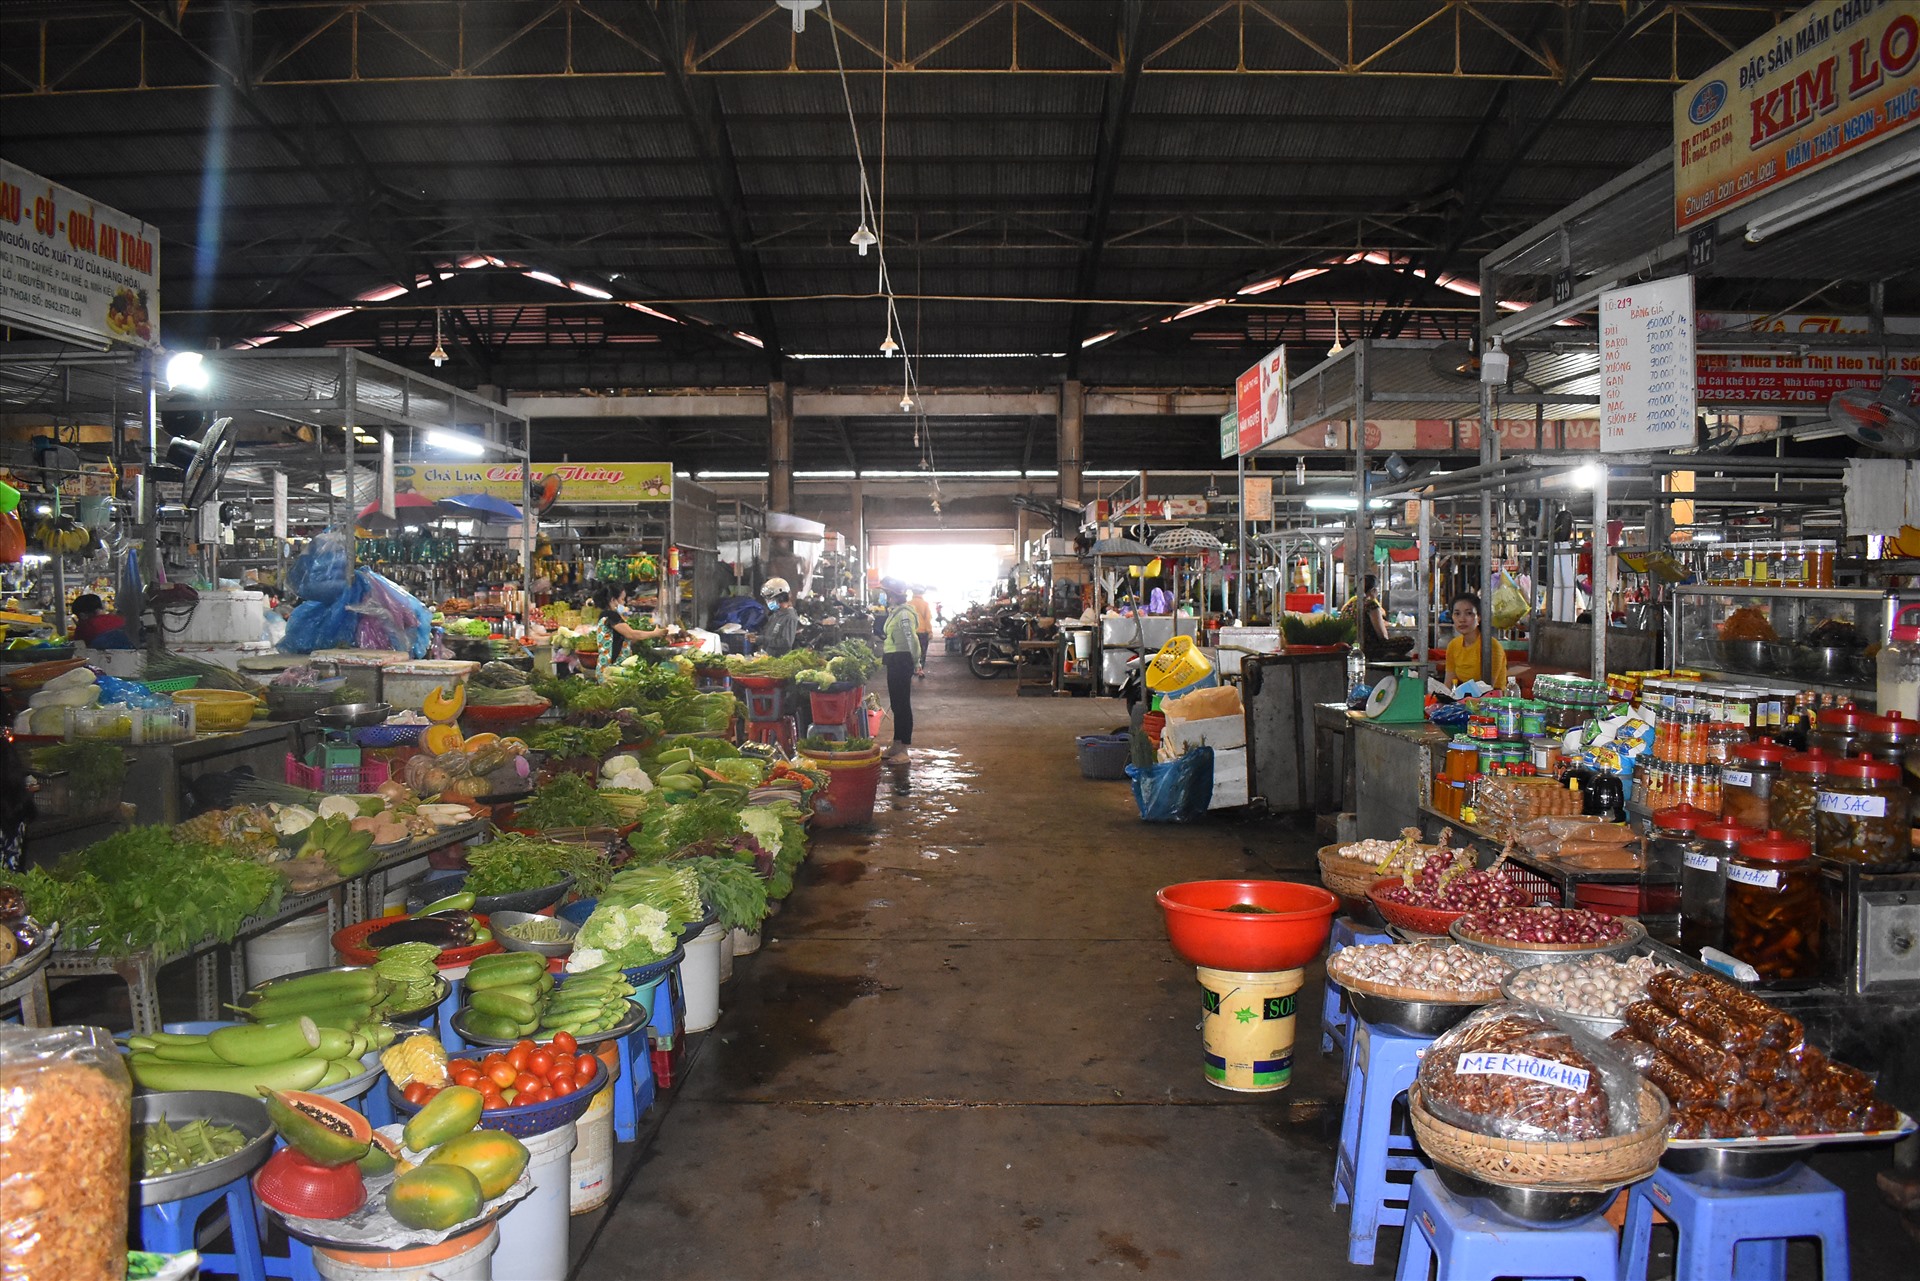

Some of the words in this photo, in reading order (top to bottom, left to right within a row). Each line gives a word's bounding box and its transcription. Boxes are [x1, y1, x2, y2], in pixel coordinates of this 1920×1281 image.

[1738, 55, 1765, 90] ĐẶC
[1767, 36, 1793, 73] SẢN
[1796, 13, 1830, 57] MẮM
[1750, 56, 1838, 149] KIM
[1785, 138, 1812, 170] MẮM
[1814, 123, 1840, 158] THẬT
[1843, 108, 1875, 143] NGON
[34, 187, 56, 239] CỦ
[68, 204, 97, 255] QUẢ
[98, 222, 119, 264] AN
[120, 230, 153, 277] TOÀN
[1630, 305, 1650, 319] BẢNG
[1741, 354, 1772, 368] Mua
[1807, 355, 1833, 372] Thịt
[1836, 355, 1863, 370] Heo
[1726, 375, 1744, 386] Khế
[1758, 377, 1776, 387] 222
[1827, 378, 1833, 387] 3
[424, 468, 452, 481] Chả
[455, 469, 483, 484] Lụa
[1463, 1056, 1498, 1071] ME
[1502, 1057, 1558, 1080] KHÔNG
